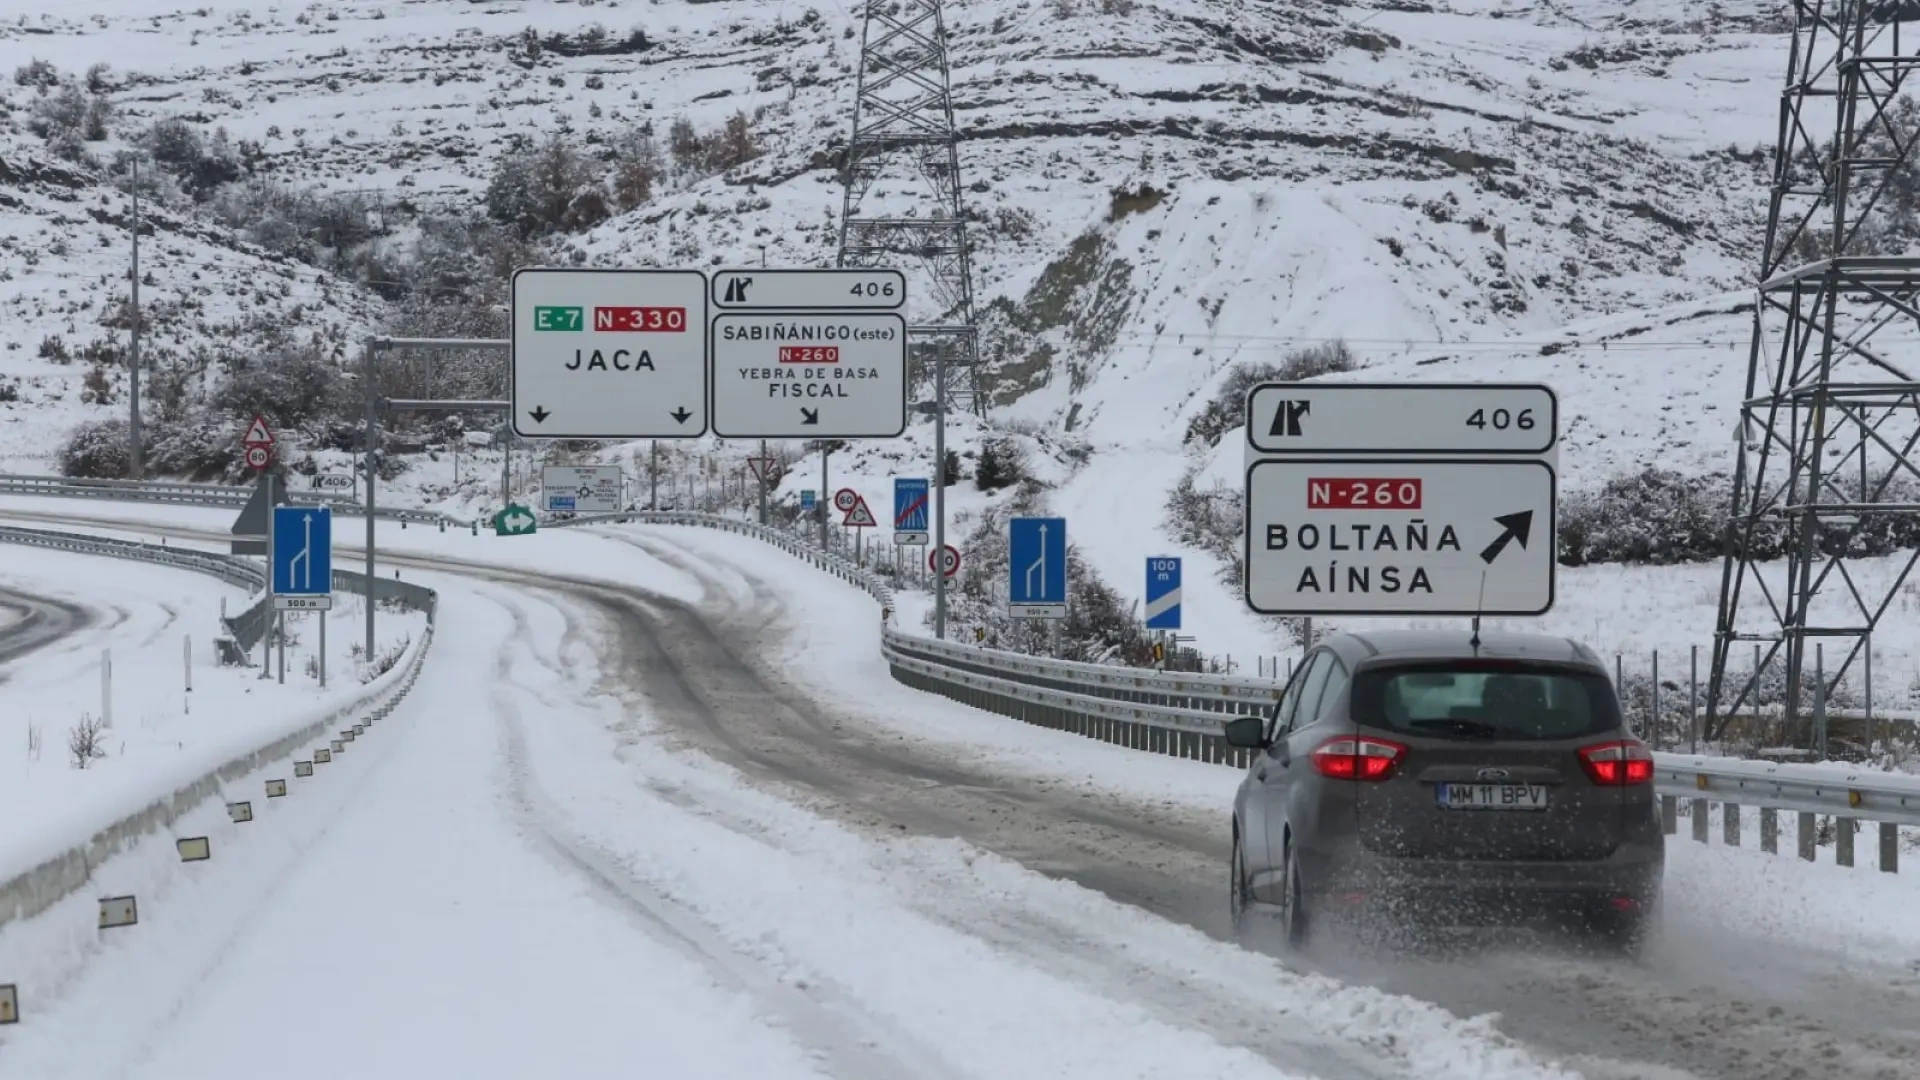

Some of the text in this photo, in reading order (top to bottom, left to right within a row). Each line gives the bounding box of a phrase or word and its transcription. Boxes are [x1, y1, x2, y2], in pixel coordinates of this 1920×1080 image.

[849, 282, 894, 297] 406
[538, 309, 682, 329] E-7 N-330
[723, 322, 895, 341] SABIÑÁNIGO (este)
[565, 349, 655, 372] JACA
[781, 348, 837, 361] N-260
[739, 367, 879, 380] YEBRA DE BASA
[769, 382, 849, 398] FISCAL
[1465, 408, 1535, 431] 406
[251, 452, 265, 462] 80
[324, 477, 348, 487] 406
[1312, 482, 1417, 505] N-260
[1266, 518, 1461, 552] BOLTAÑA
[1152, 560, 1176, 571] 100
[1158, 573, 1169, 581] m
[1296, 560, 1433, 594] AÍNSA
[287, 599, 306, 607] 500
[1449, 786, 1541, 804] MM 11 BPV
